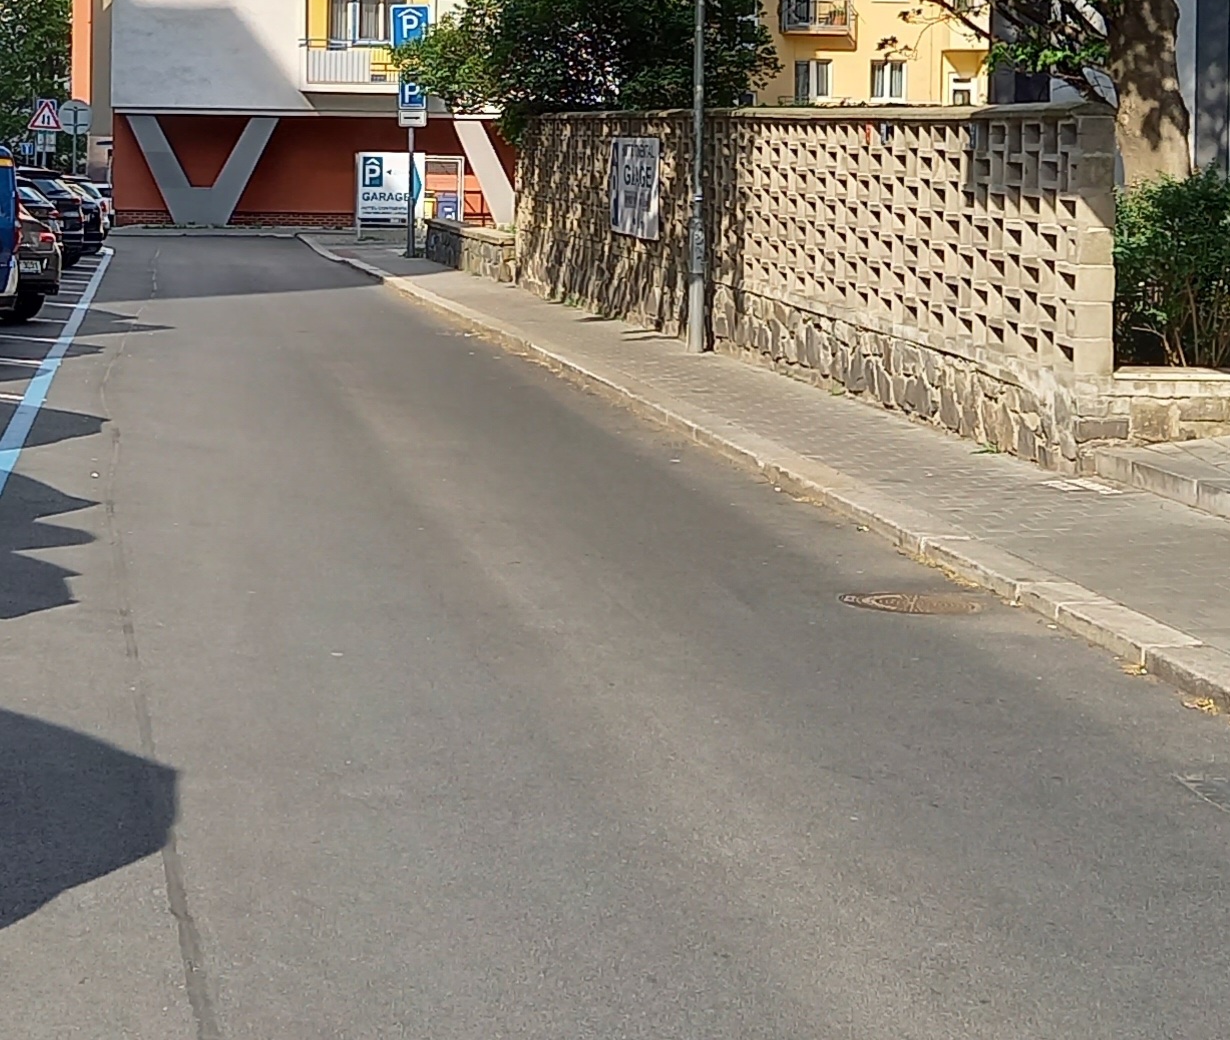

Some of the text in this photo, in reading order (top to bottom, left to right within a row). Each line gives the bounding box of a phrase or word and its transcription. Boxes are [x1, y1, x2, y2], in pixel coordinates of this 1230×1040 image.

[402, 14, 418, 39] P
[404, 82, 420, 103] P
[364, 164, 381, 186] P
[362, 192, 410, 202] GARAGE
